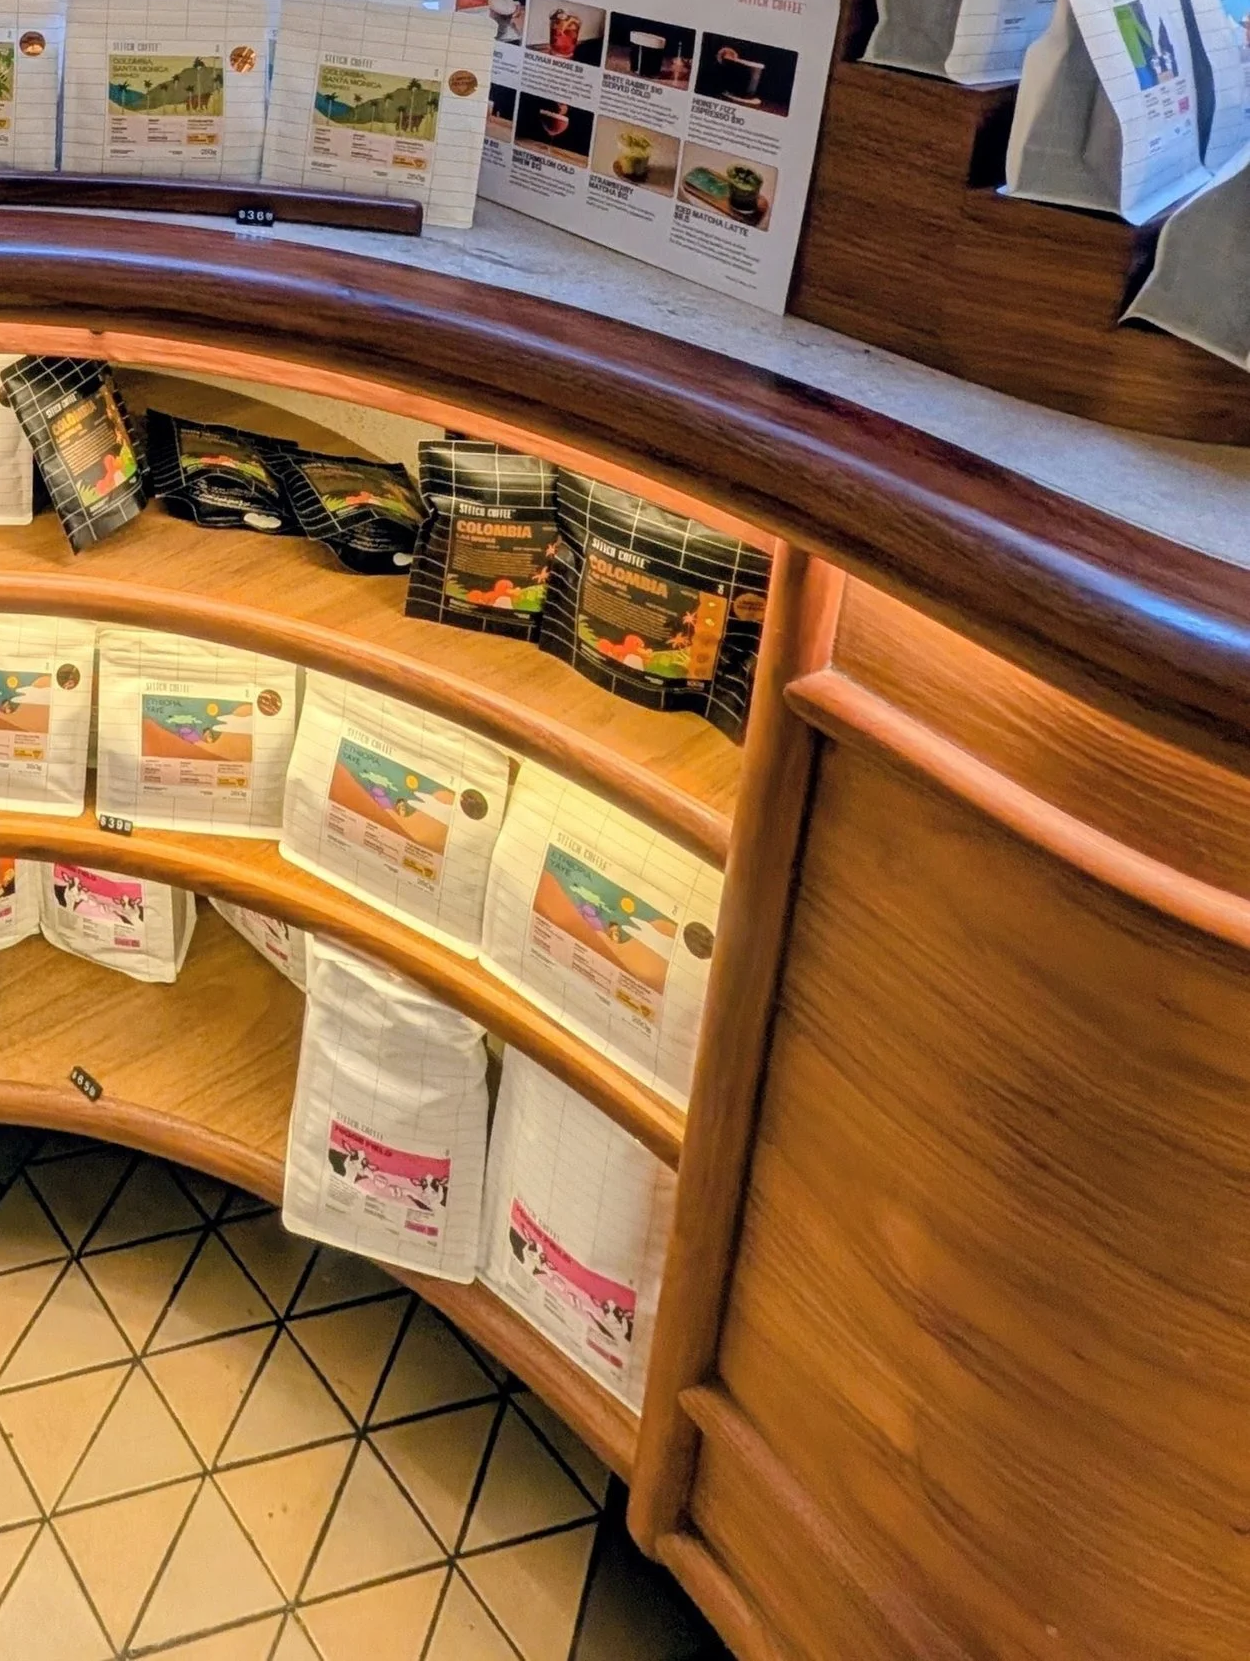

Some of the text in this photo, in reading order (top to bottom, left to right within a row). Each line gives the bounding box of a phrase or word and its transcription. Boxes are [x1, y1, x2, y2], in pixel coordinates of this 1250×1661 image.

[550, 59, 572, 71] MOOSE
[322, 75, 382, 89] SANTA MONICA
[603, 74, 623, 84] WHITE
[625, 78, 649, 91] RABBIT
[691, 105, 731, 123] ESPRESSO
[692, 97, 737, 114] HONEY FIZZ
[512, 156, 530, 167] BREW
[512, 149, 575, 175] WATERMELON COLD
[589, 175, 634, 195] STRAWBERRY
[692, 210, 723, 228] MATCHA
[724, 220, 749, 237] LATTE
[51, 400, 97, 436] COLOMBIA
[459, 503, 512, 519] STITCH COFFEE
[457, 520, 532, 538] COLOMBIA
[592, 538, 646, 569] STITCH COFFEE
[589, 554, 668, 599] COLOMBIA
[557, 832, 607, 870] STITCH COFFEE
